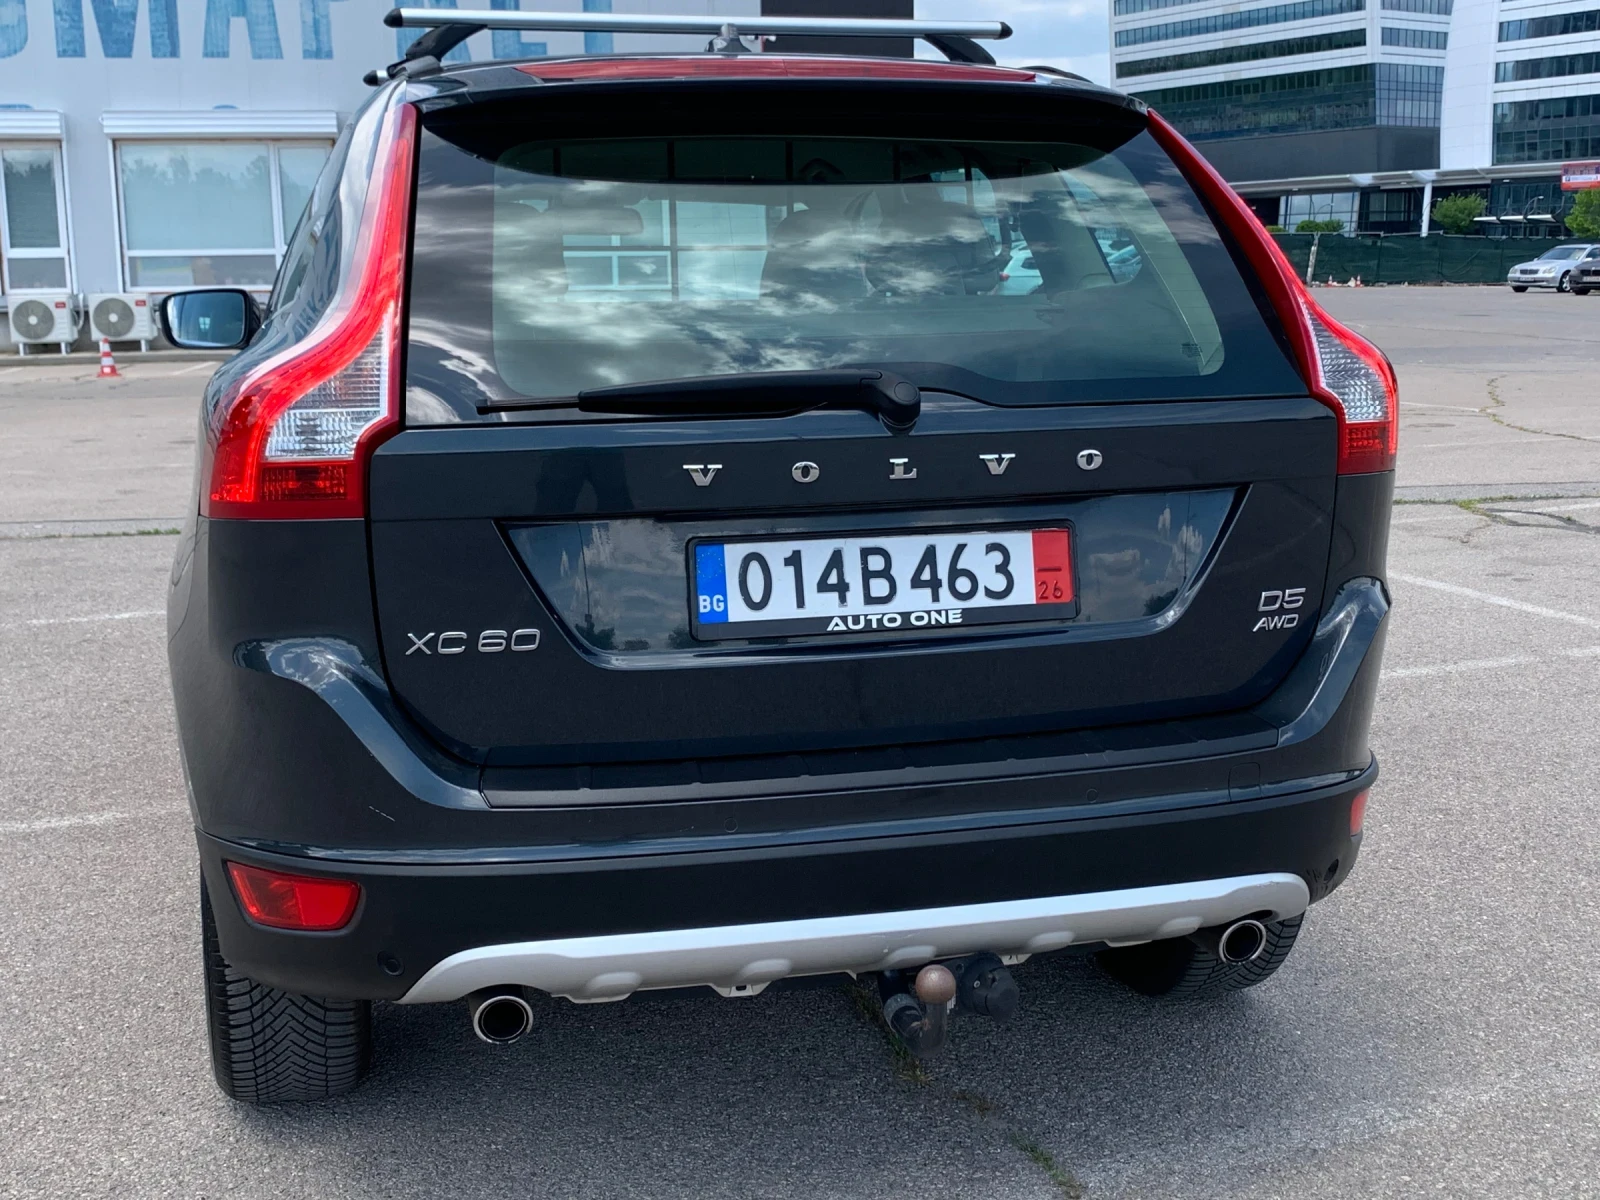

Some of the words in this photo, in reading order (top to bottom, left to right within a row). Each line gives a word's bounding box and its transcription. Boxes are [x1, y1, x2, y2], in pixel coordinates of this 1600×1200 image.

[682, 448, 1103, 487] VOLVO
[1038, 580, 1064, 600] 26
[1257, 587, 1307, 612] D5
[699, 594, 725, 613] BG
[826, 612, 902, 632] AUTO
[909, 608, 963, 627] ONE
[1252, 613, 1299, 633] AWD
[405, 631, 468, 656] XC
[477, 628, 541, 653] 60
